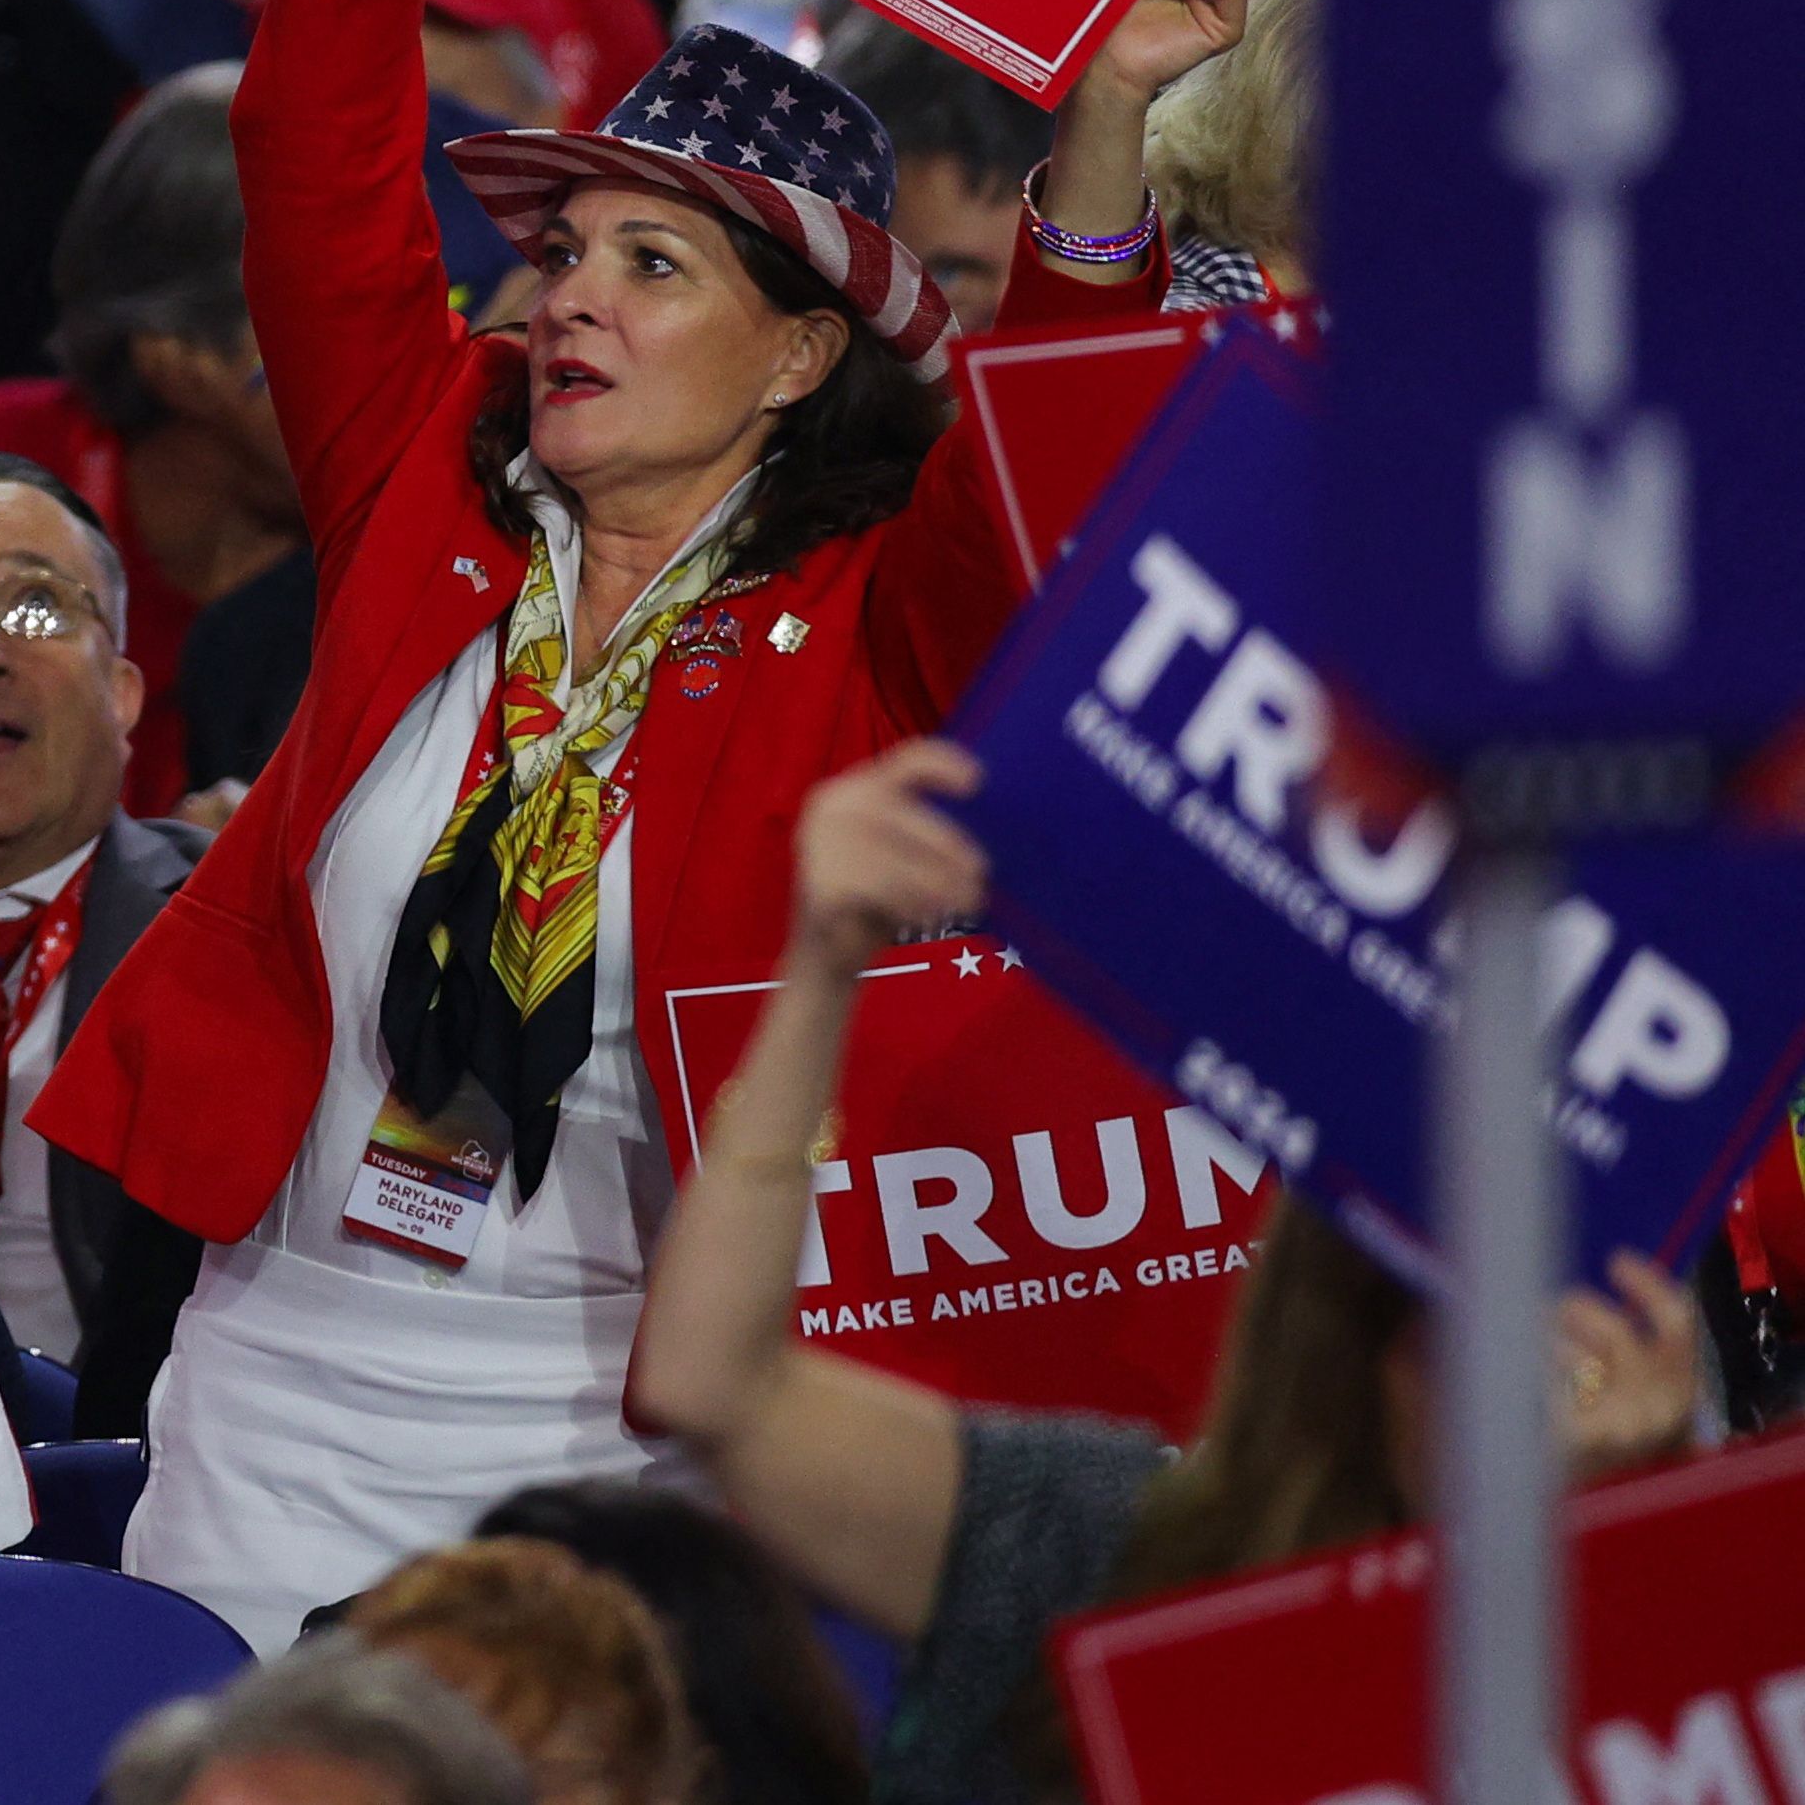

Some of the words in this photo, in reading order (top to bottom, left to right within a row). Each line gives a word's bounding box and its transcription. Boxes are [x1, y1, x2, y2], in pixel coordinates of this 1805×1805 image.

[1095, 532, 1732, 1103] TRUP
[371, 1152, 427, 1179] TUESDAY
[379, 1178, 463, 1216] MARYLAND
[796, 1105, 1270, 1288] TRUM
[377, 1194, 456, 1230] DELEGATE
[801, 1299, 915, 1337] MAKE
[931, 1267, 1121, 1321] AMERICA
[1135, 1241, 1265, 1287] GREA
